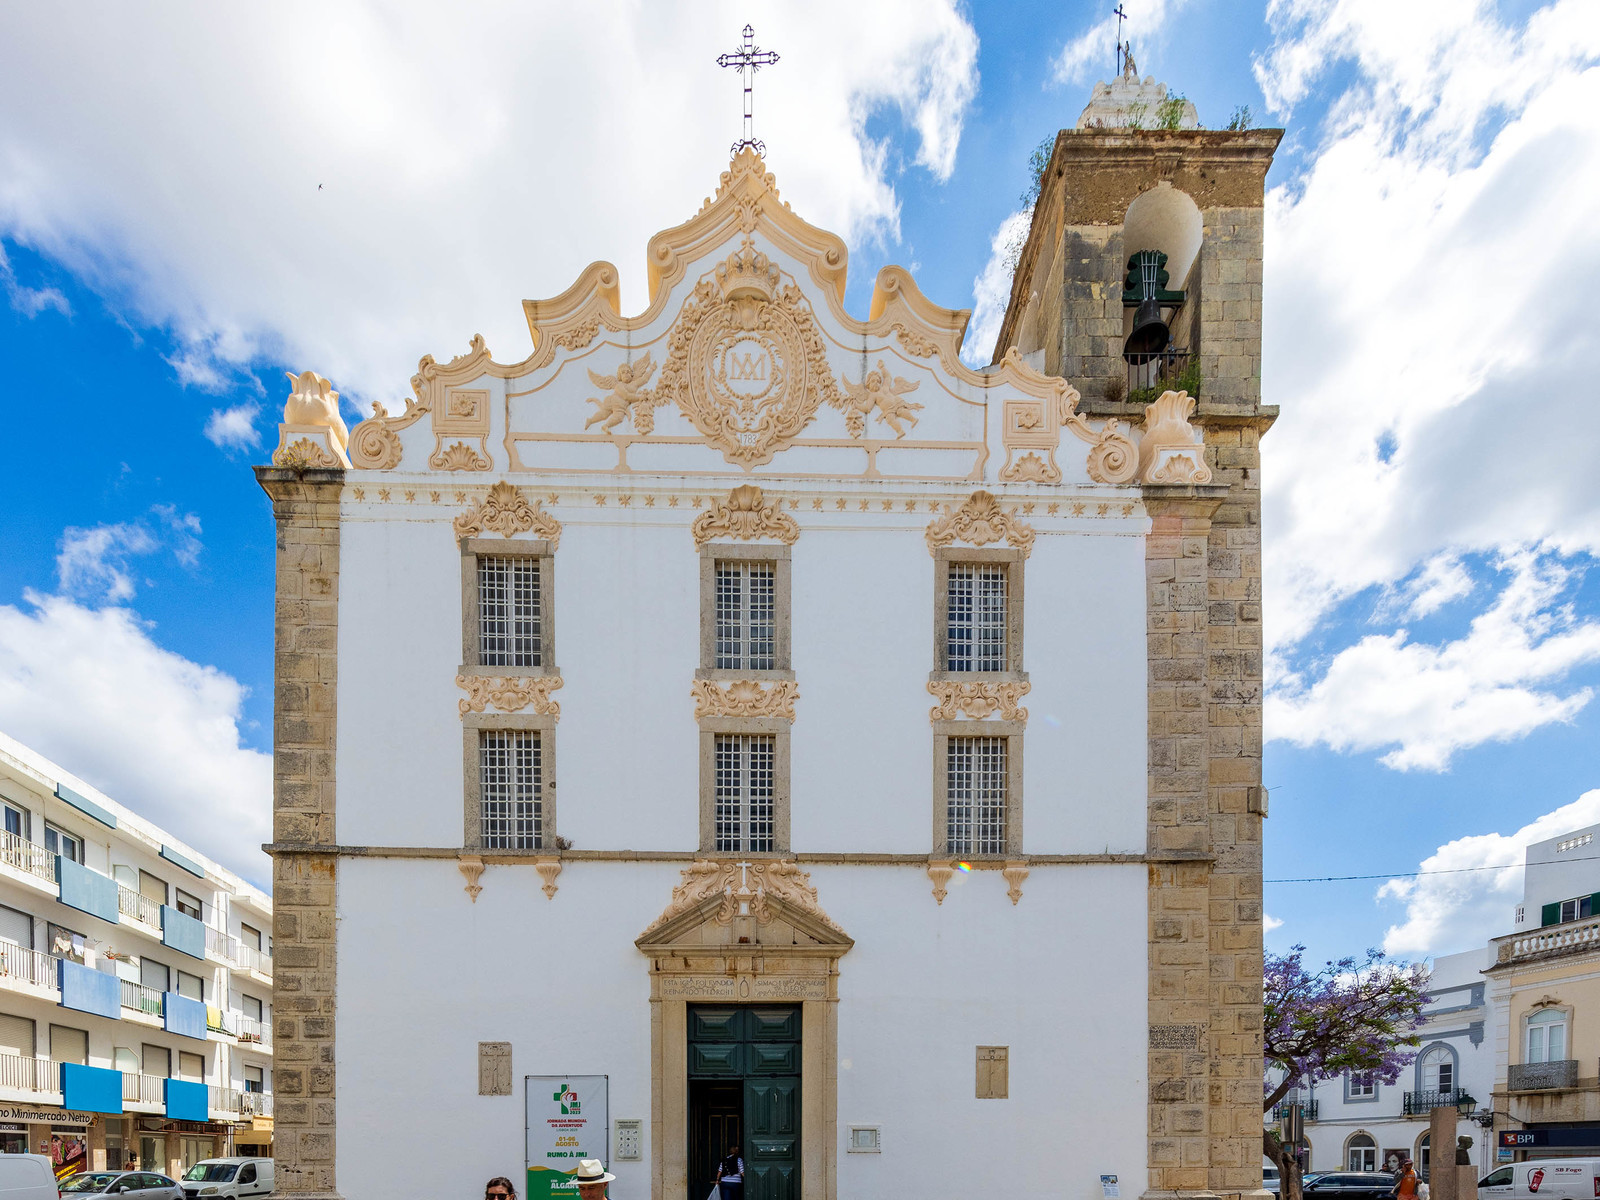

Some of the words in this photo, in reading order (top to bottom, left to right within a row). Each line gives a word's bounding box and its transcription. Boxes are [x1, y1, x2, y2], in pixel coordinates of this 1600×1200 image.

[11, 1108, 67, 1121] Minimercado
[68, 1112, 91, 1122] Netto
[1517, 1134, 1535, 1143] BPI
